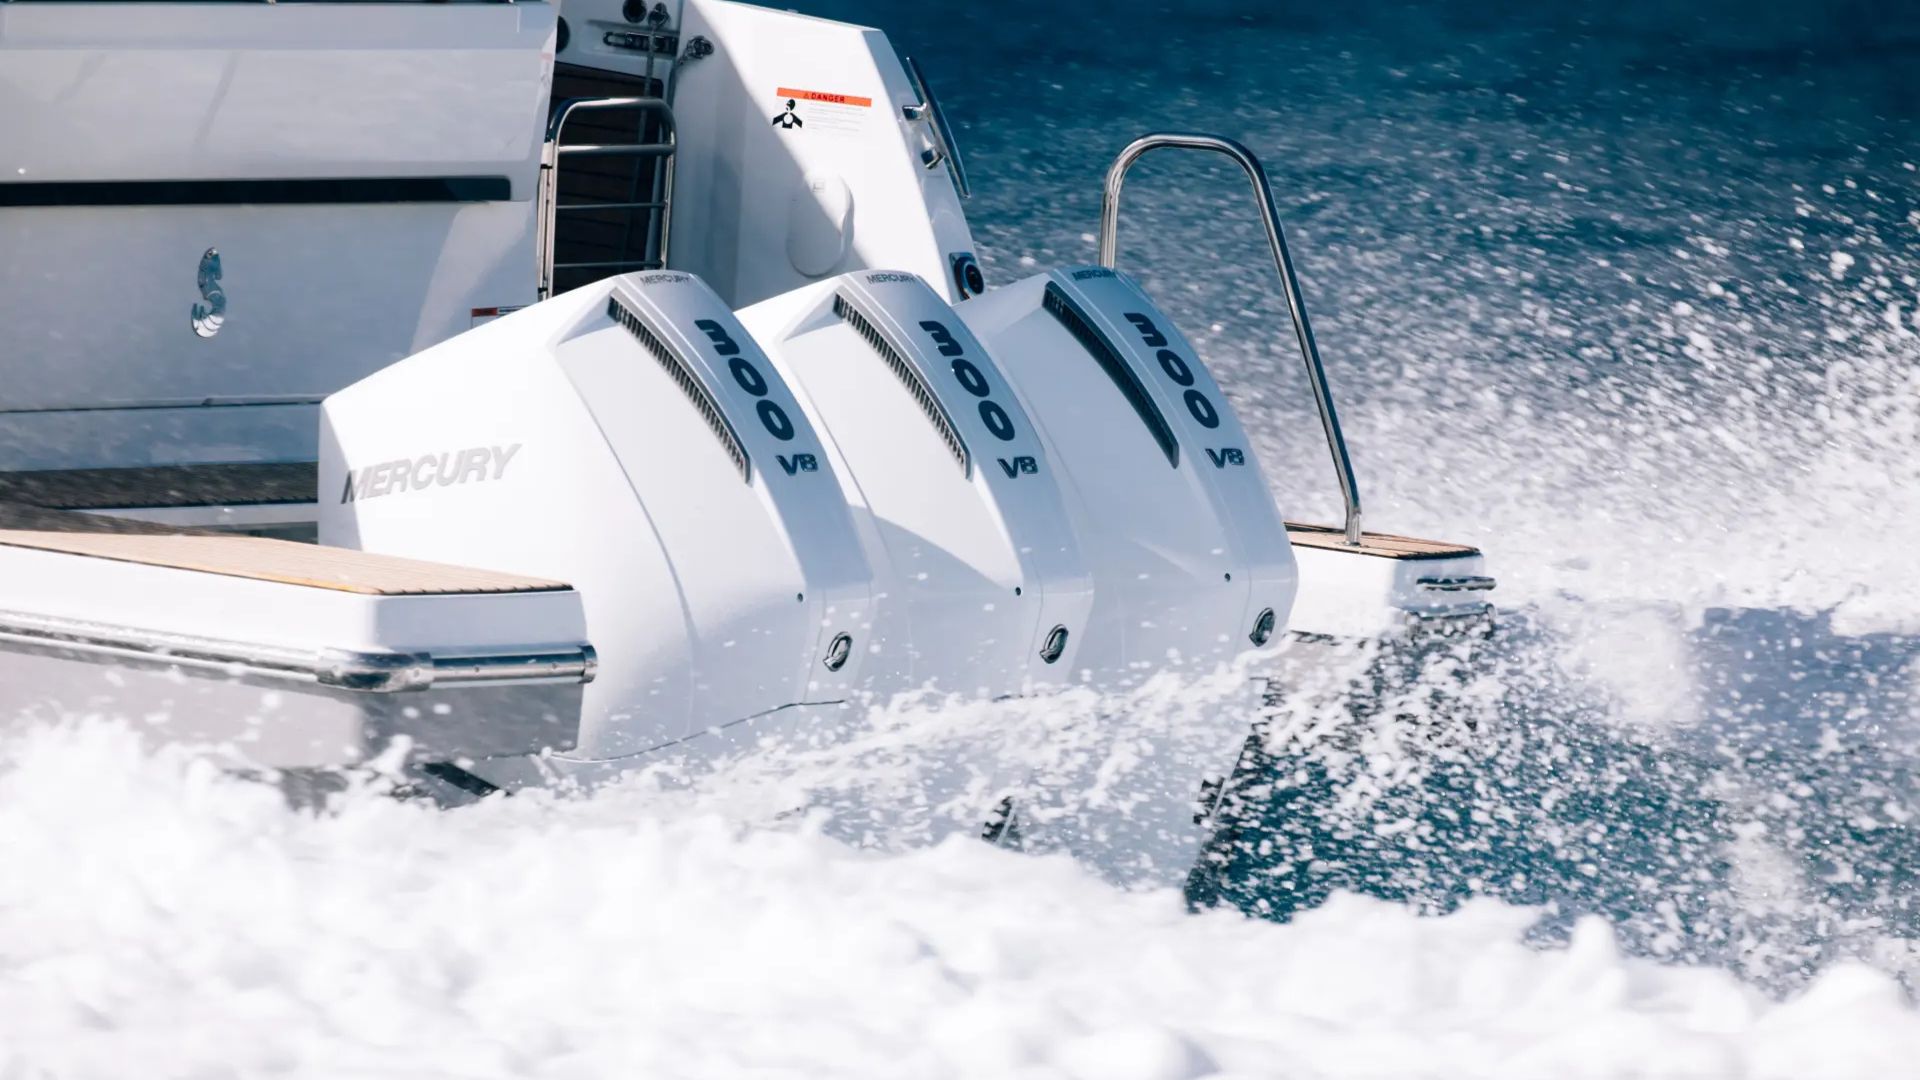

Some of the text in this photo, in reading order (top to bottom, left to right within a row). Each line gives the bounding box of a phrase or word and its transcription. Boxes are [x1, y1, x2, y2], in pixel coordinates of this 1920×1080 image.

[811, 92, 845, 103] DANGER
[640, 273, 690, 286] MERCURY
[866, 273, 916, 285] MERCURY
[694, 319, 795, 441] 300
[918, 320, 1016, 442] 300
[1123, 312, 1220, 429] 300
[775, 453, 818, 476] V8
[996, 456, 1039, 479] V8
[1204, 448, 1245, 469] V8
[340, 443, 523, 505] MERCURY
